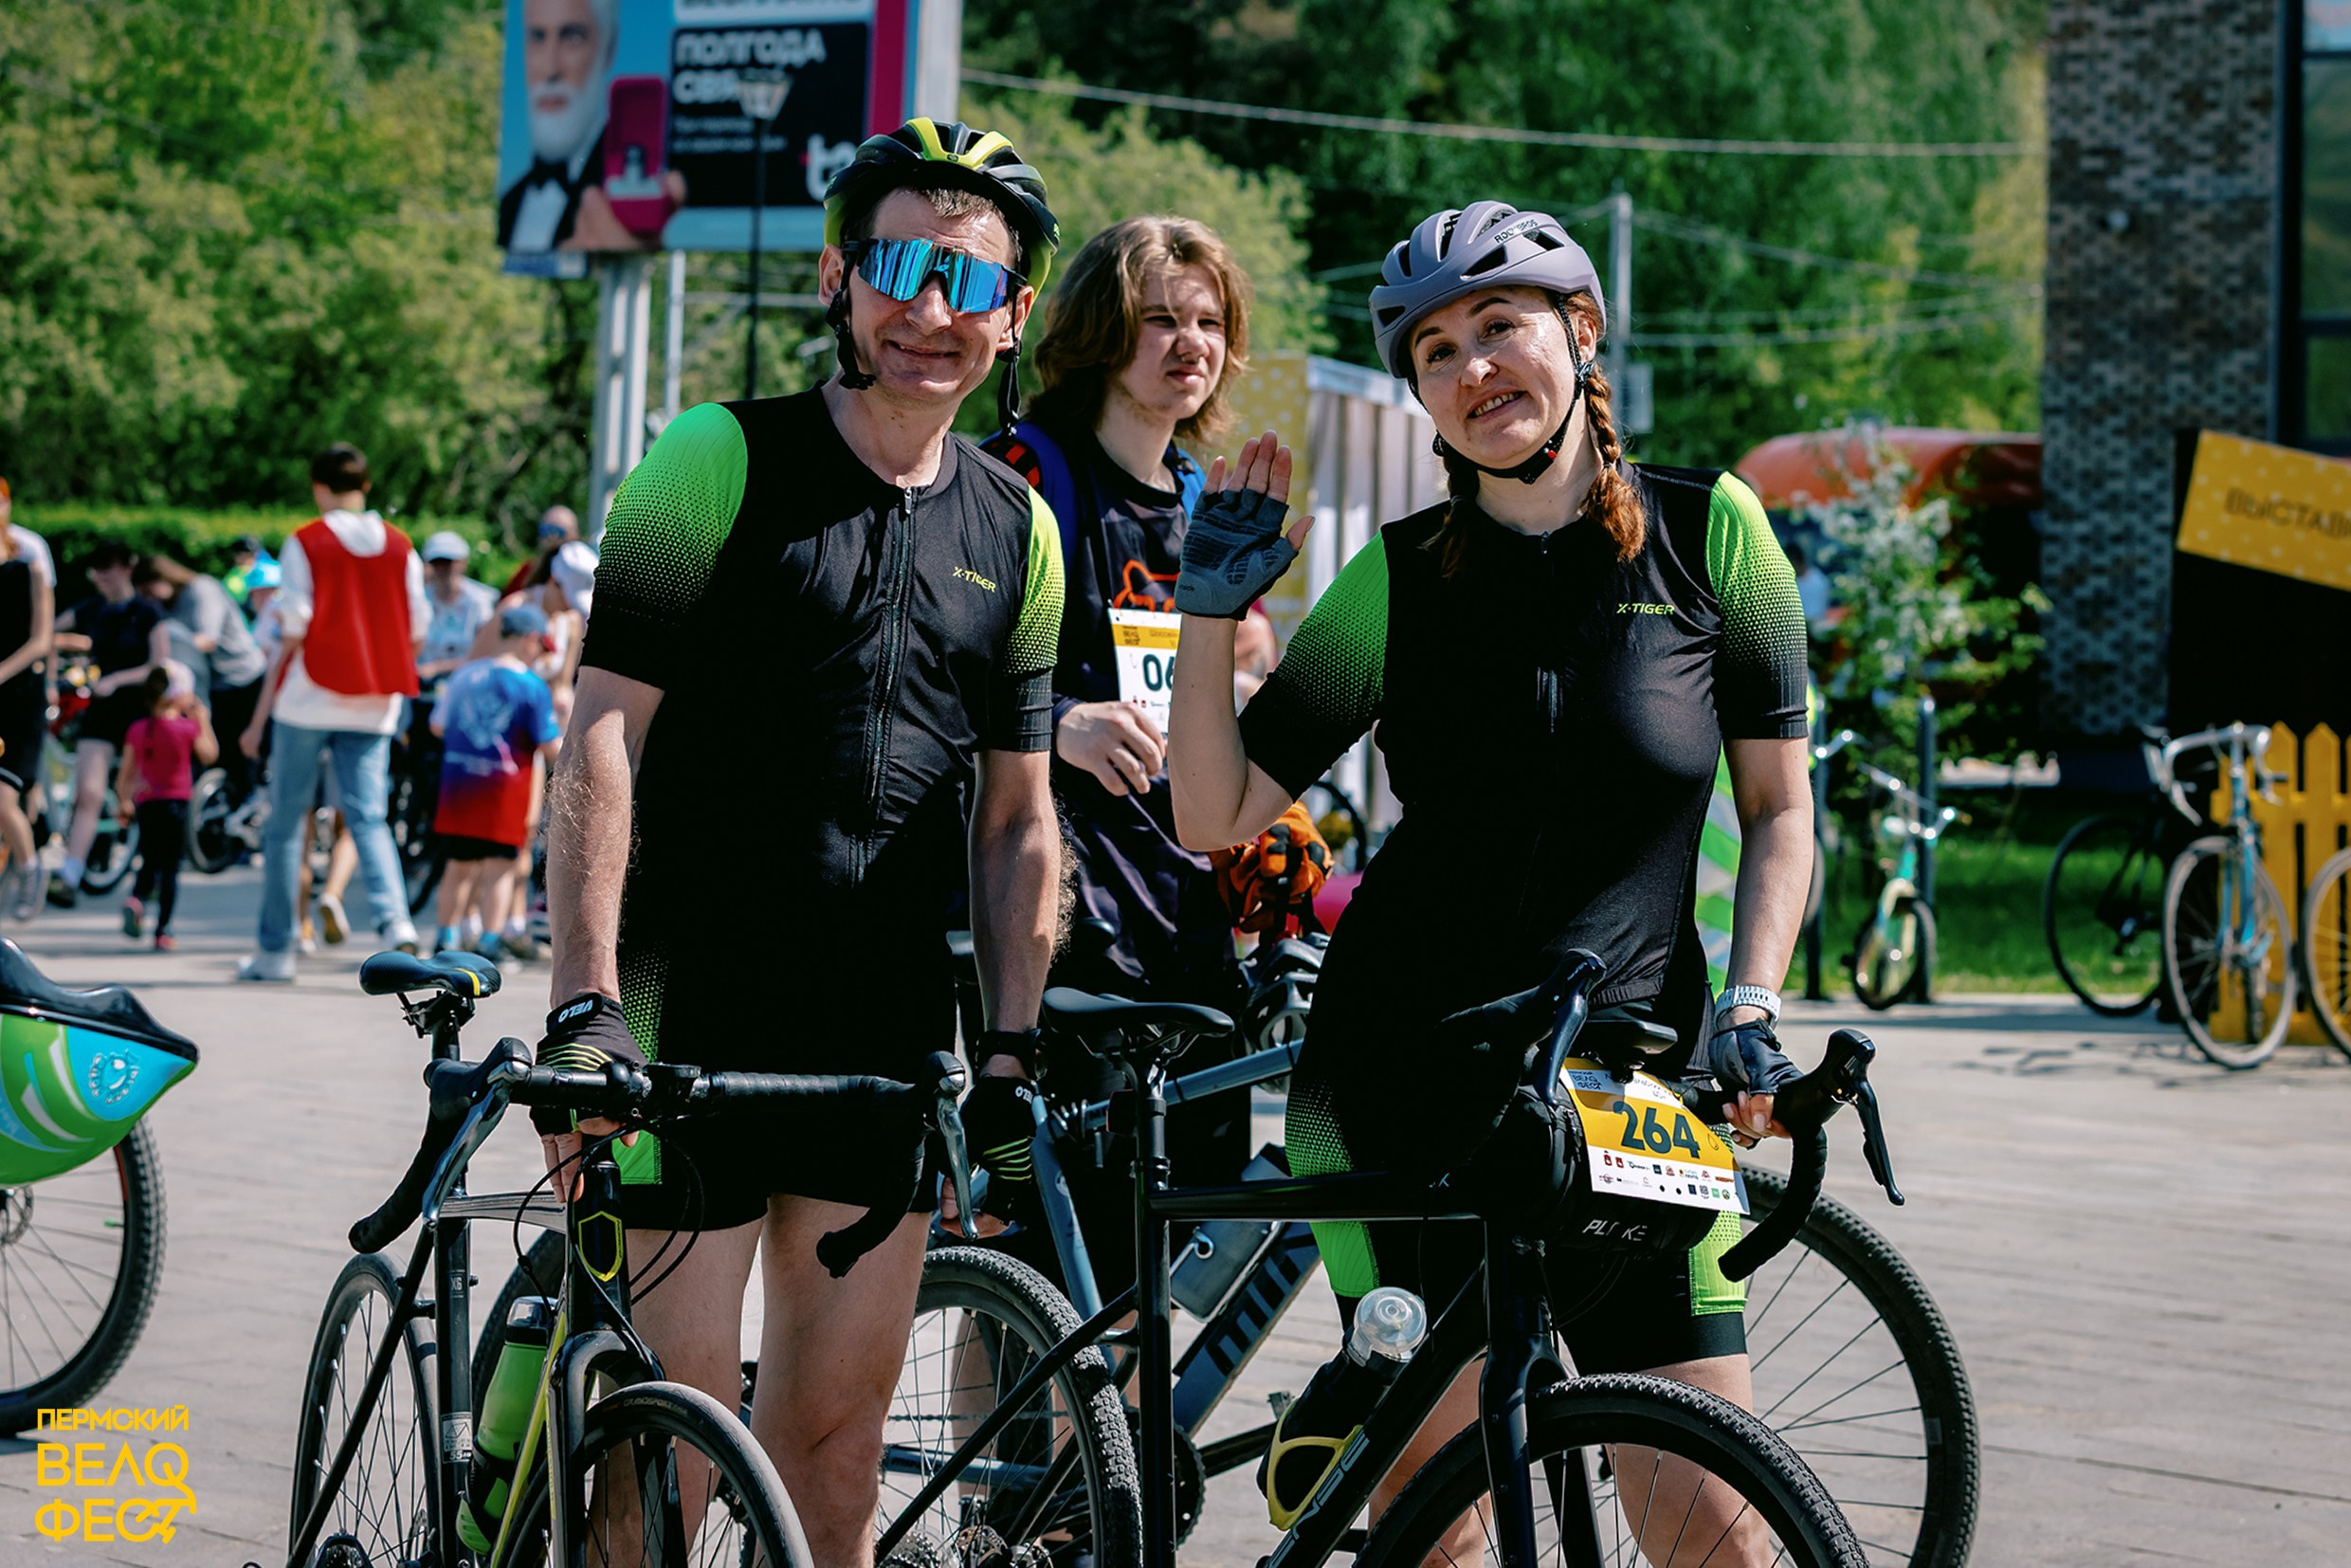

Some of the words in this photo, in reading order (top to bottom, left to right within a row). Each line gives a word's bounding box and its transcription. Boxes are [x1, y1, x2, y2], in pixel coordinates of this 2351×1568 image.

[677, 27, 827, 69] ПОЛГОДА
[672, 68, 747, 104] СВЯ
[1494, 219, 1539, 244] ROCBROS
[2224, 486, 2351, 540] ВЫСТАВ
[1613, 1100, 1701, 1159] 264
